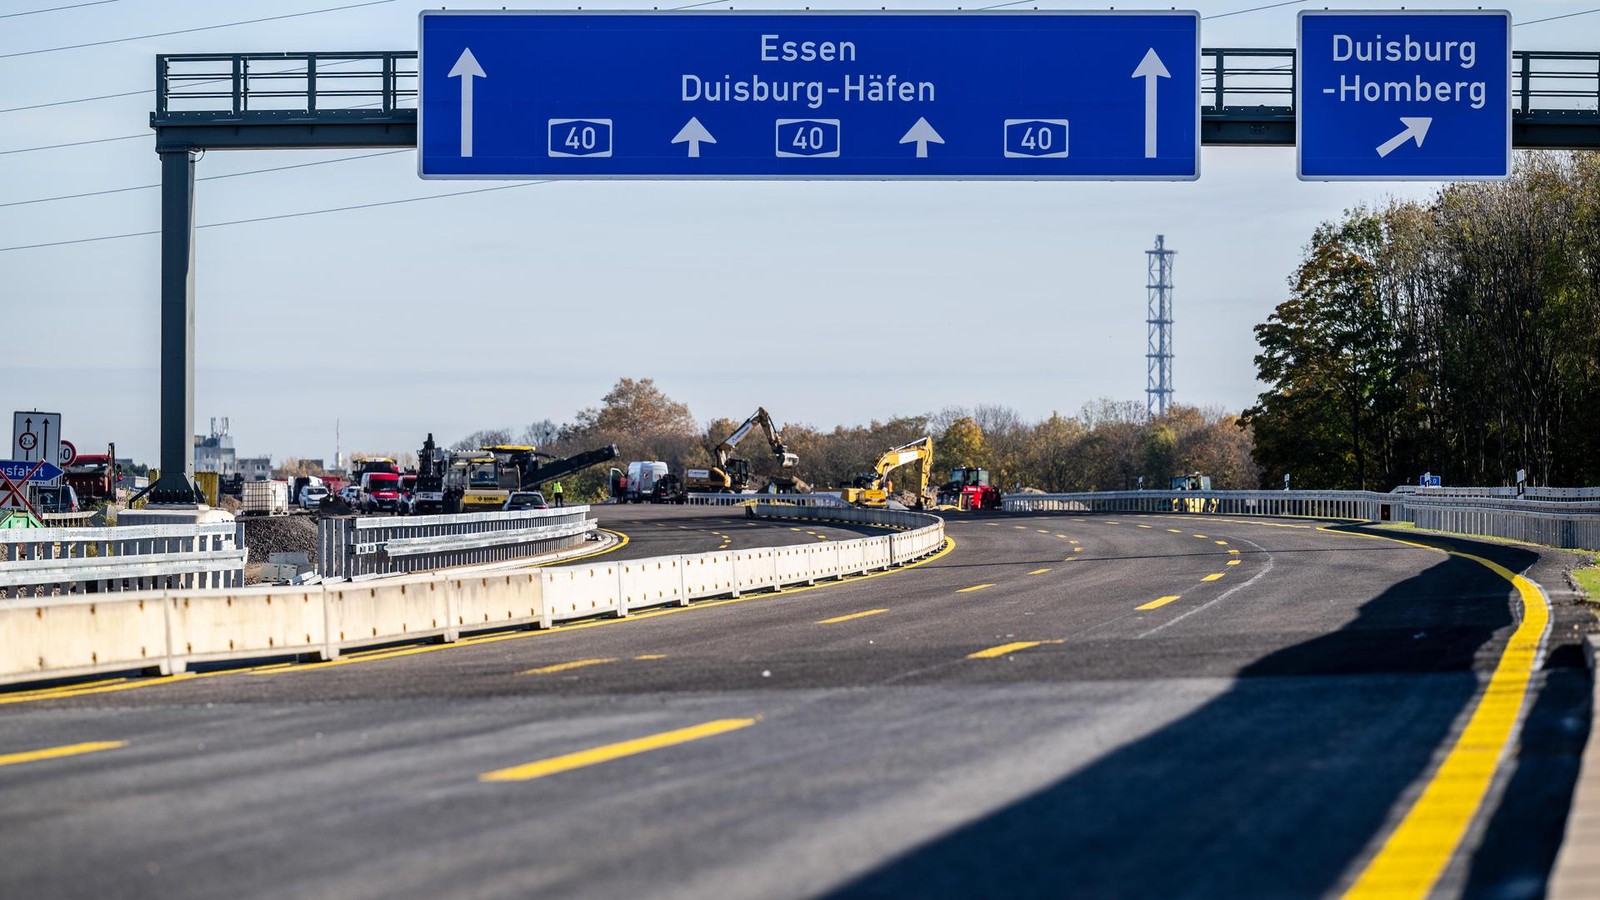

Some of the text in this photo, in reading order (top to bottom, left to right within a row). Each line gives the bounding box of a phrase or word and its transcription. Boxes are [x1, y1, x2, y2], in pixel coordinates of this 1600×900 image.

[762, 35, 855, 61] Essen
[1333, 35, 1475, 68] Duisburg
[682, 75, 934, 108] Duisburg-Häfen
[1323, 75, 1485, 109] -Homberg
[565, 127, 595, 149] 40
[793, 127, 823, 149] 40
[1021, 128, 1051, 149] 40
